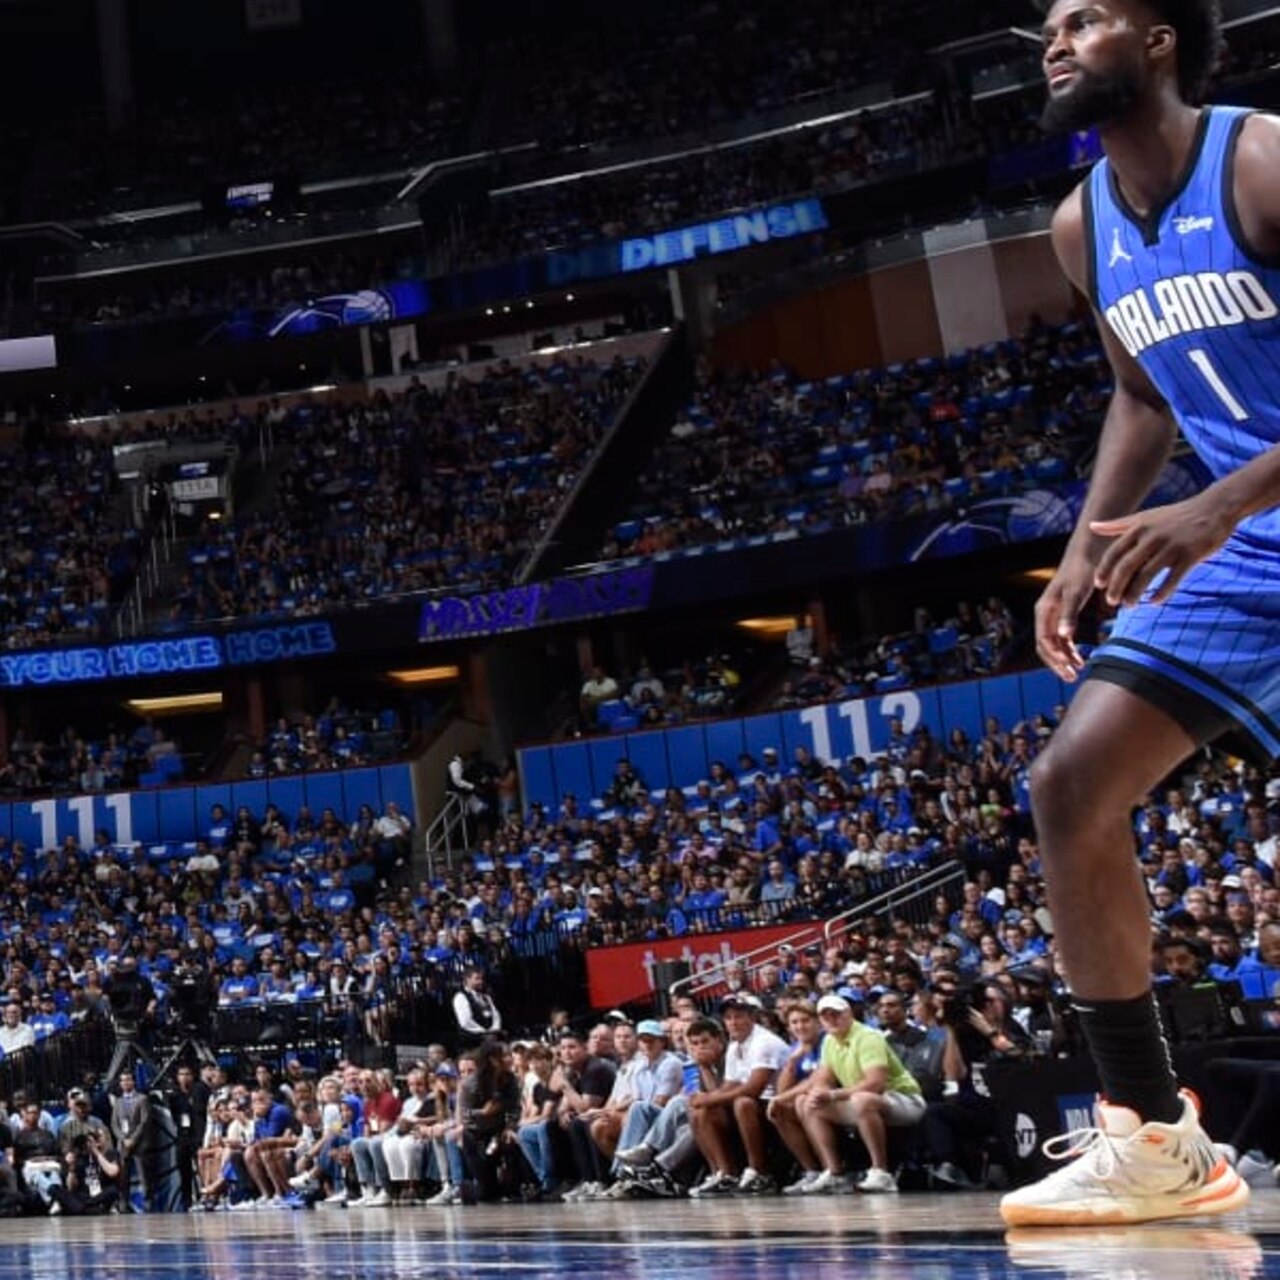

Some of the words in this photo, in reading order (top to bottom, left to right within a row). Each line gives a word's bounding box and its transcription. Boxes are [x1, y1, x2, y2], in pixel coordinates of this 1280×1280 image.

[1105, 271, 1279, 357] ORLANDO
[1188, 349, 1249, 421] 1
[0, 649, 105, 685] YOUR
[108, 636, 221, 676] HOME
[32, 793, 141, 858] 111
